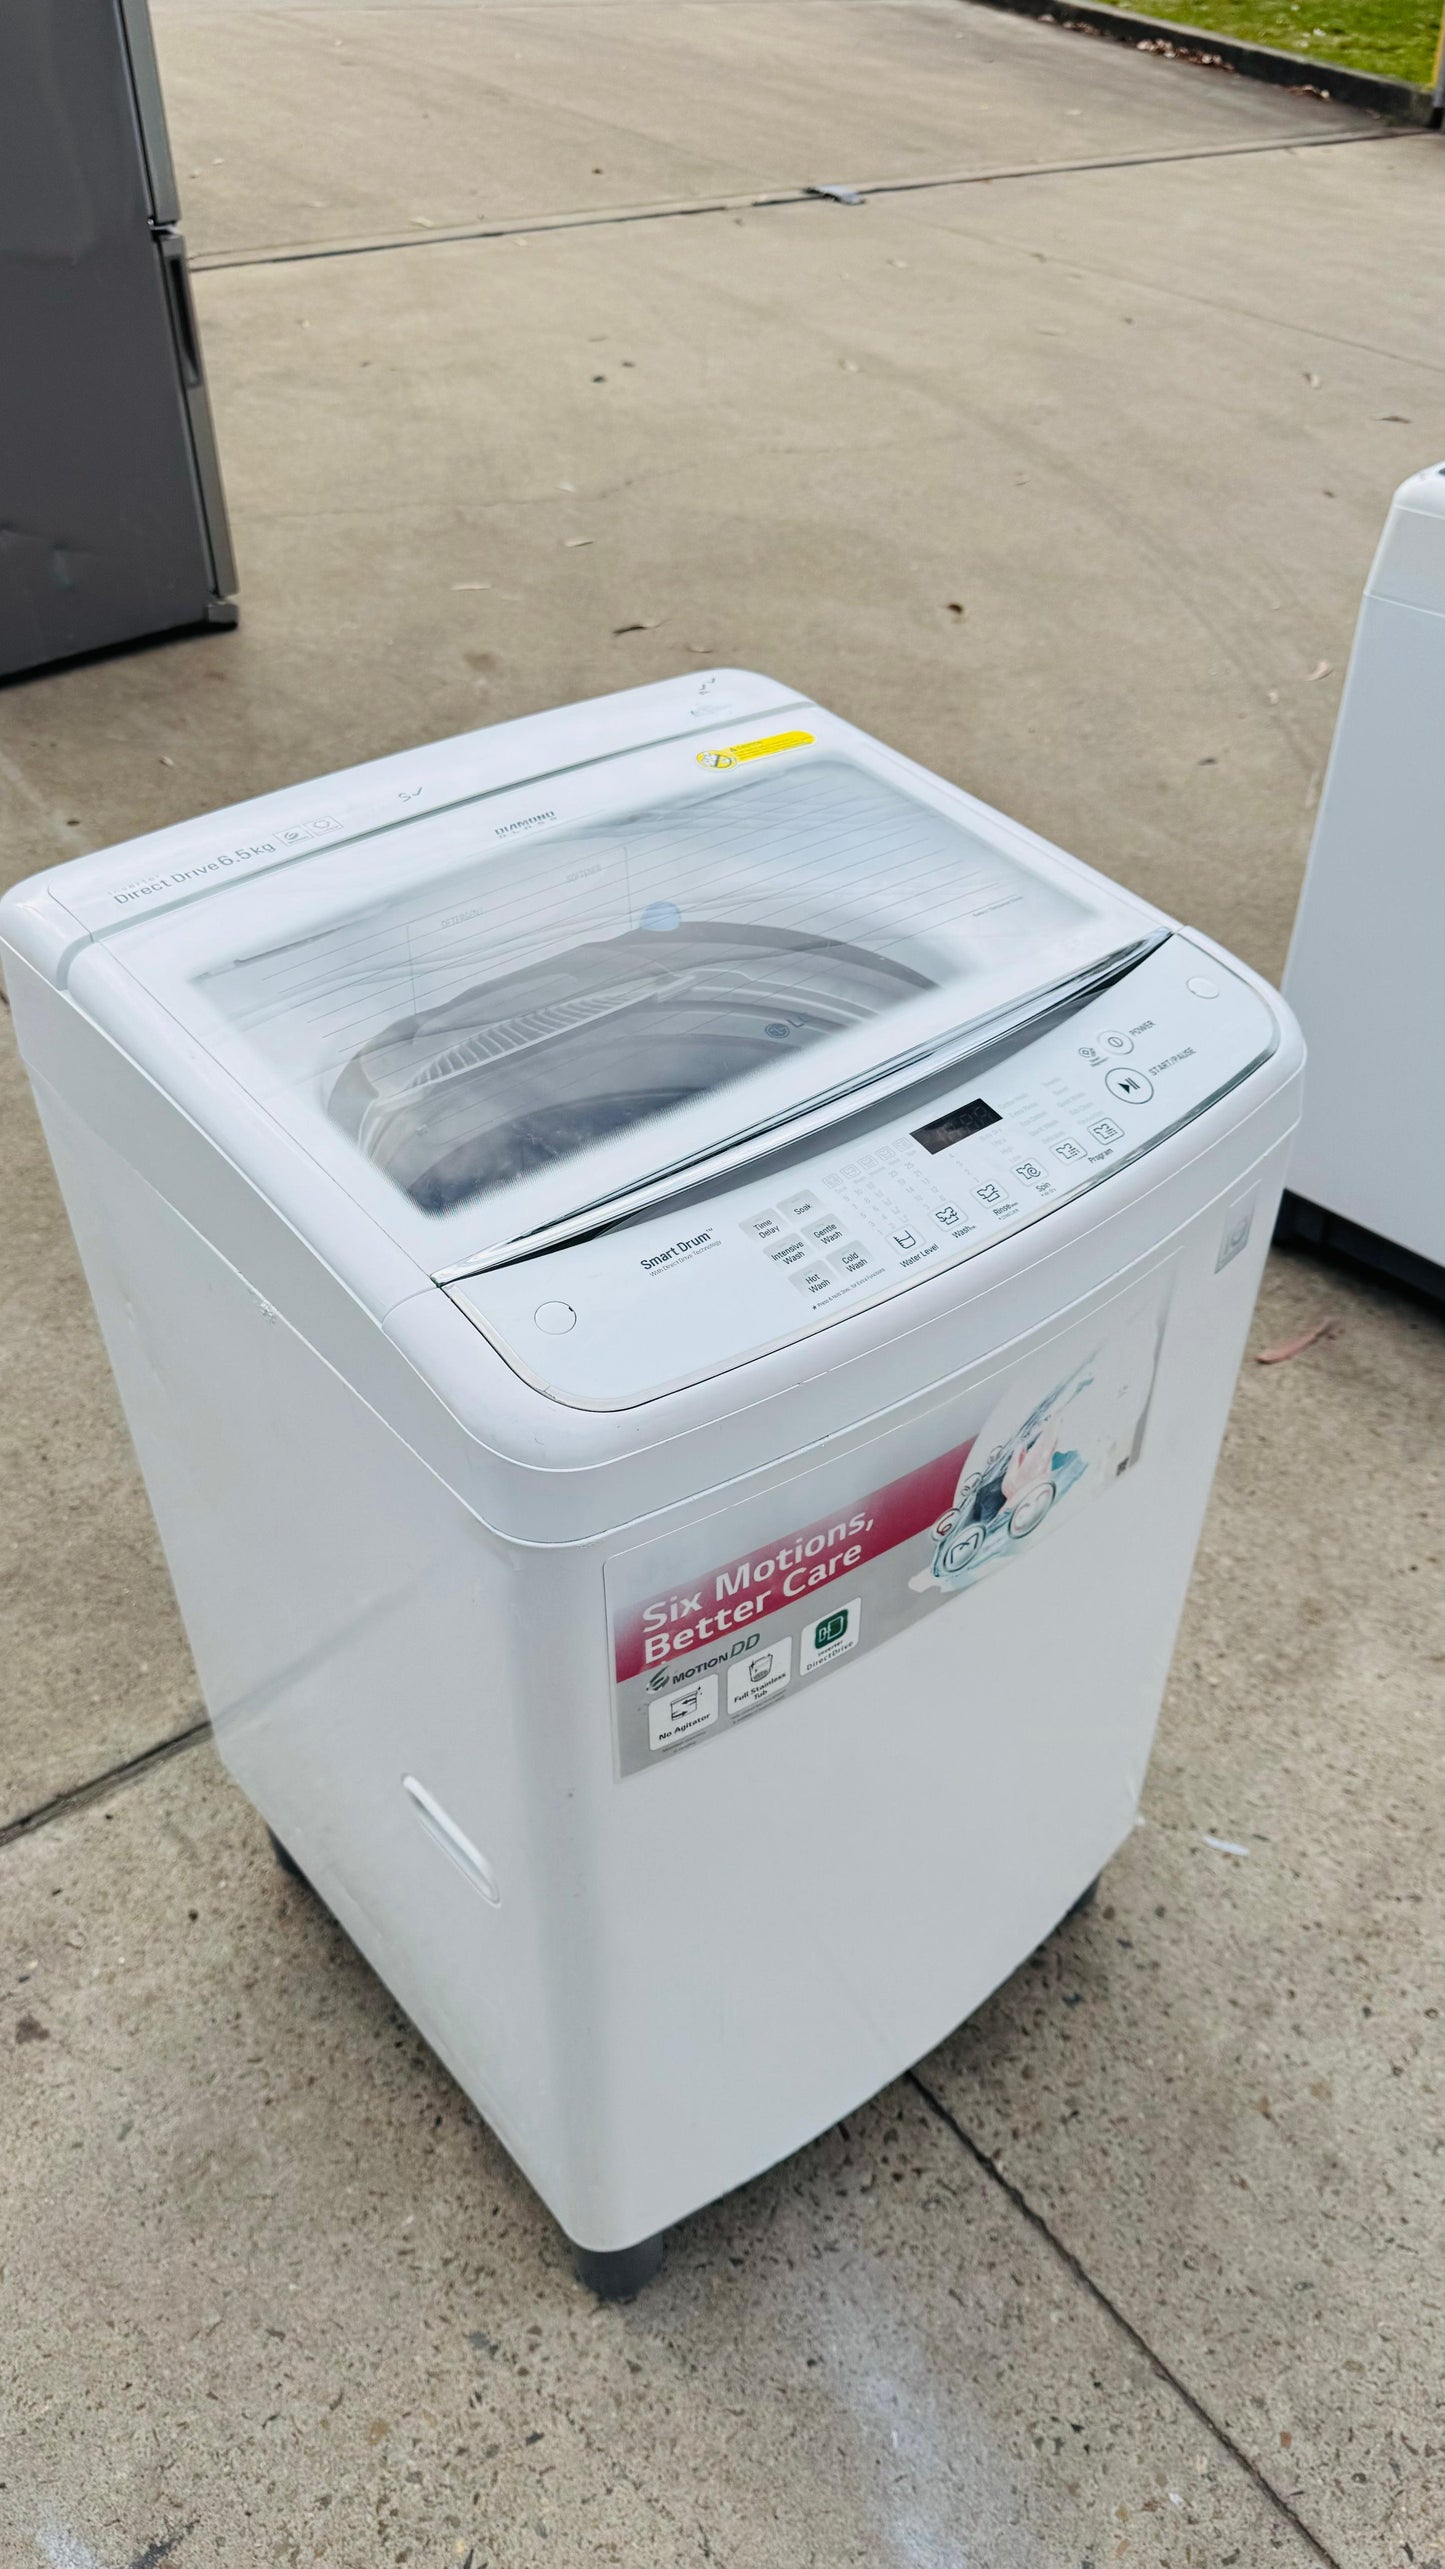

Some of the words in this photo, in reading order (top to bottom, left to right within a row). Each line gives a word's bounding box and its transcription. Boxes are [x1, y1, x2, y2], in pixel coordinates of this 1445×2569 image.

[494, 811, 556, 835] DIAMOND
[113, 880, 171, 904] Direct
[171, 862, 219, 885] Drive
[1129, 1020, 1156, 1036] POWER
[1149, 1047, 1197, 1076] START/PAUSE
[1087, 1148, 1114, 1164] Program
[1036, 1182, 1051, 1192] Spin
[793, 1203, 812, 1215] Soak
[993, 1203, 1012, 1215] Rinse
[753, 1219, 772, 1231] Time
[758, 1225, 780, 1239] Delay
[813, 1223, 837, 1238] Gentle
[952, 1225, 972, 1239] Wash
[820, 1231, 843, 1244] Wash
[640, 1247, 679, 1270] Smart
[771, 1241, 805, 1261] Intensive
[782, 1250, 806, 1265] Wash
[841, 1252, 859, 1265] Cold
[900, 1253, 923, 1269] Water
[920, 1243, 940, 1260] Level
[846, 1257, 868, 1273] Wash
[805, 1274, 821, 1285] Hot
[808, 1278, 831, 1294] Wash
[642, 1591, 702, 1633] Six
[715, 1512, 874, 1601] Motions,
[644, 1590, 772, 1664] Better
[782, 1543, 862, 1597] Care
[734, 1691, 750, 1704] Full
[750, 1672, 787, 1696] Stainless
[754, 1689, 769, 1700] Tub
[658, 1731, 673, 1741] No
[674, 1713, 711, 1735] Agitator
